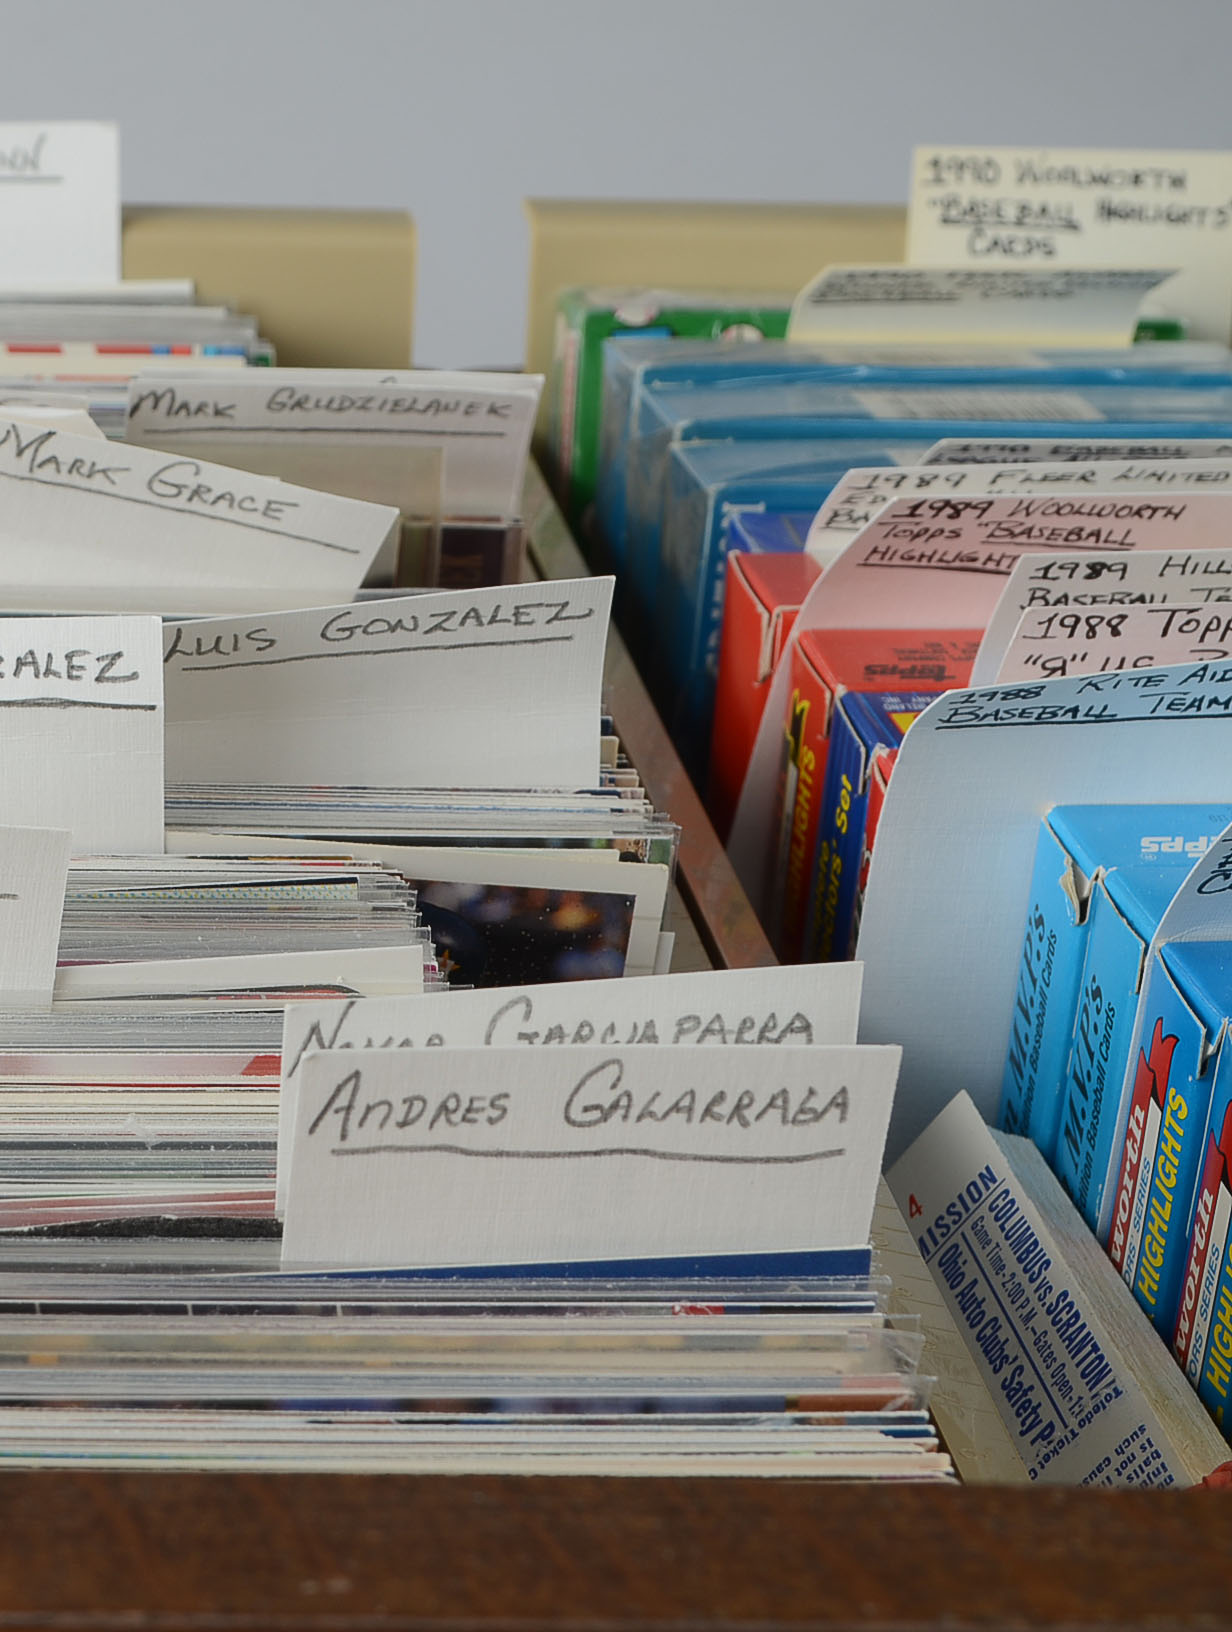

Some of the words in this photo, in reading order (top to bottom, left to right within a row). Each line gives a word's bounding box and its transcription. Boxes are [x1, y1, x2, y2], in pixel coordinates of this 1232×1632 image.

[128, 387, 236, 420] MARK
[146, 462, 301, 522] GRACE
[856, 471, 968, 492] 1989
[989, 468, 1099, 486] FLEER
[891, 499, 994, 520] 1989
[1007, 499, 1187, 522] WOOLWORTH
[1028, 561, 1129, 581] 1989
[163, 627, 277, 665] LUIS
[320, 601, 595, 643] GONZALEZ
[1022, 612, 1129, 640] 1988
[948, 685, 1047, 705] 1988
[1076, 672, 1169, 695] RITE
[937, 703, 1119, 724] BASEBALL
[1041, 929, 1058, 988] Cards
[1086, 1060, 1107, 1150] Baseball
[1098, 1001, 1116, 1063] Cards
[564, 1058, 850, 1129] GALARRAGA
[908, 1192, 923, 1218] 4
[1132, 1157, 1152, 1233] SERIES
[1137, 1086, 1189, 1306] HIGHLIGHTS
[970, 1215, 993, 1250] Game
[987, 1187, 1052, 1284] COLUMBUS
[1045, 1289, 1113, 1392] SCRANTON
[1199, 1243, 1220, 1322] SERIES
[937, 1242, 967, 1291] Ohio
[954, 1278, 987, 1330] Auto
[1001, 1364, 1043, 1437] Safety
[1077, 1386, 1124, 1430] Toledo
[1114, 1423, 1147, 1456] such
[1081, 1455, 1113, 1489] caus
[1114, 1451, 1137, 1477] not
